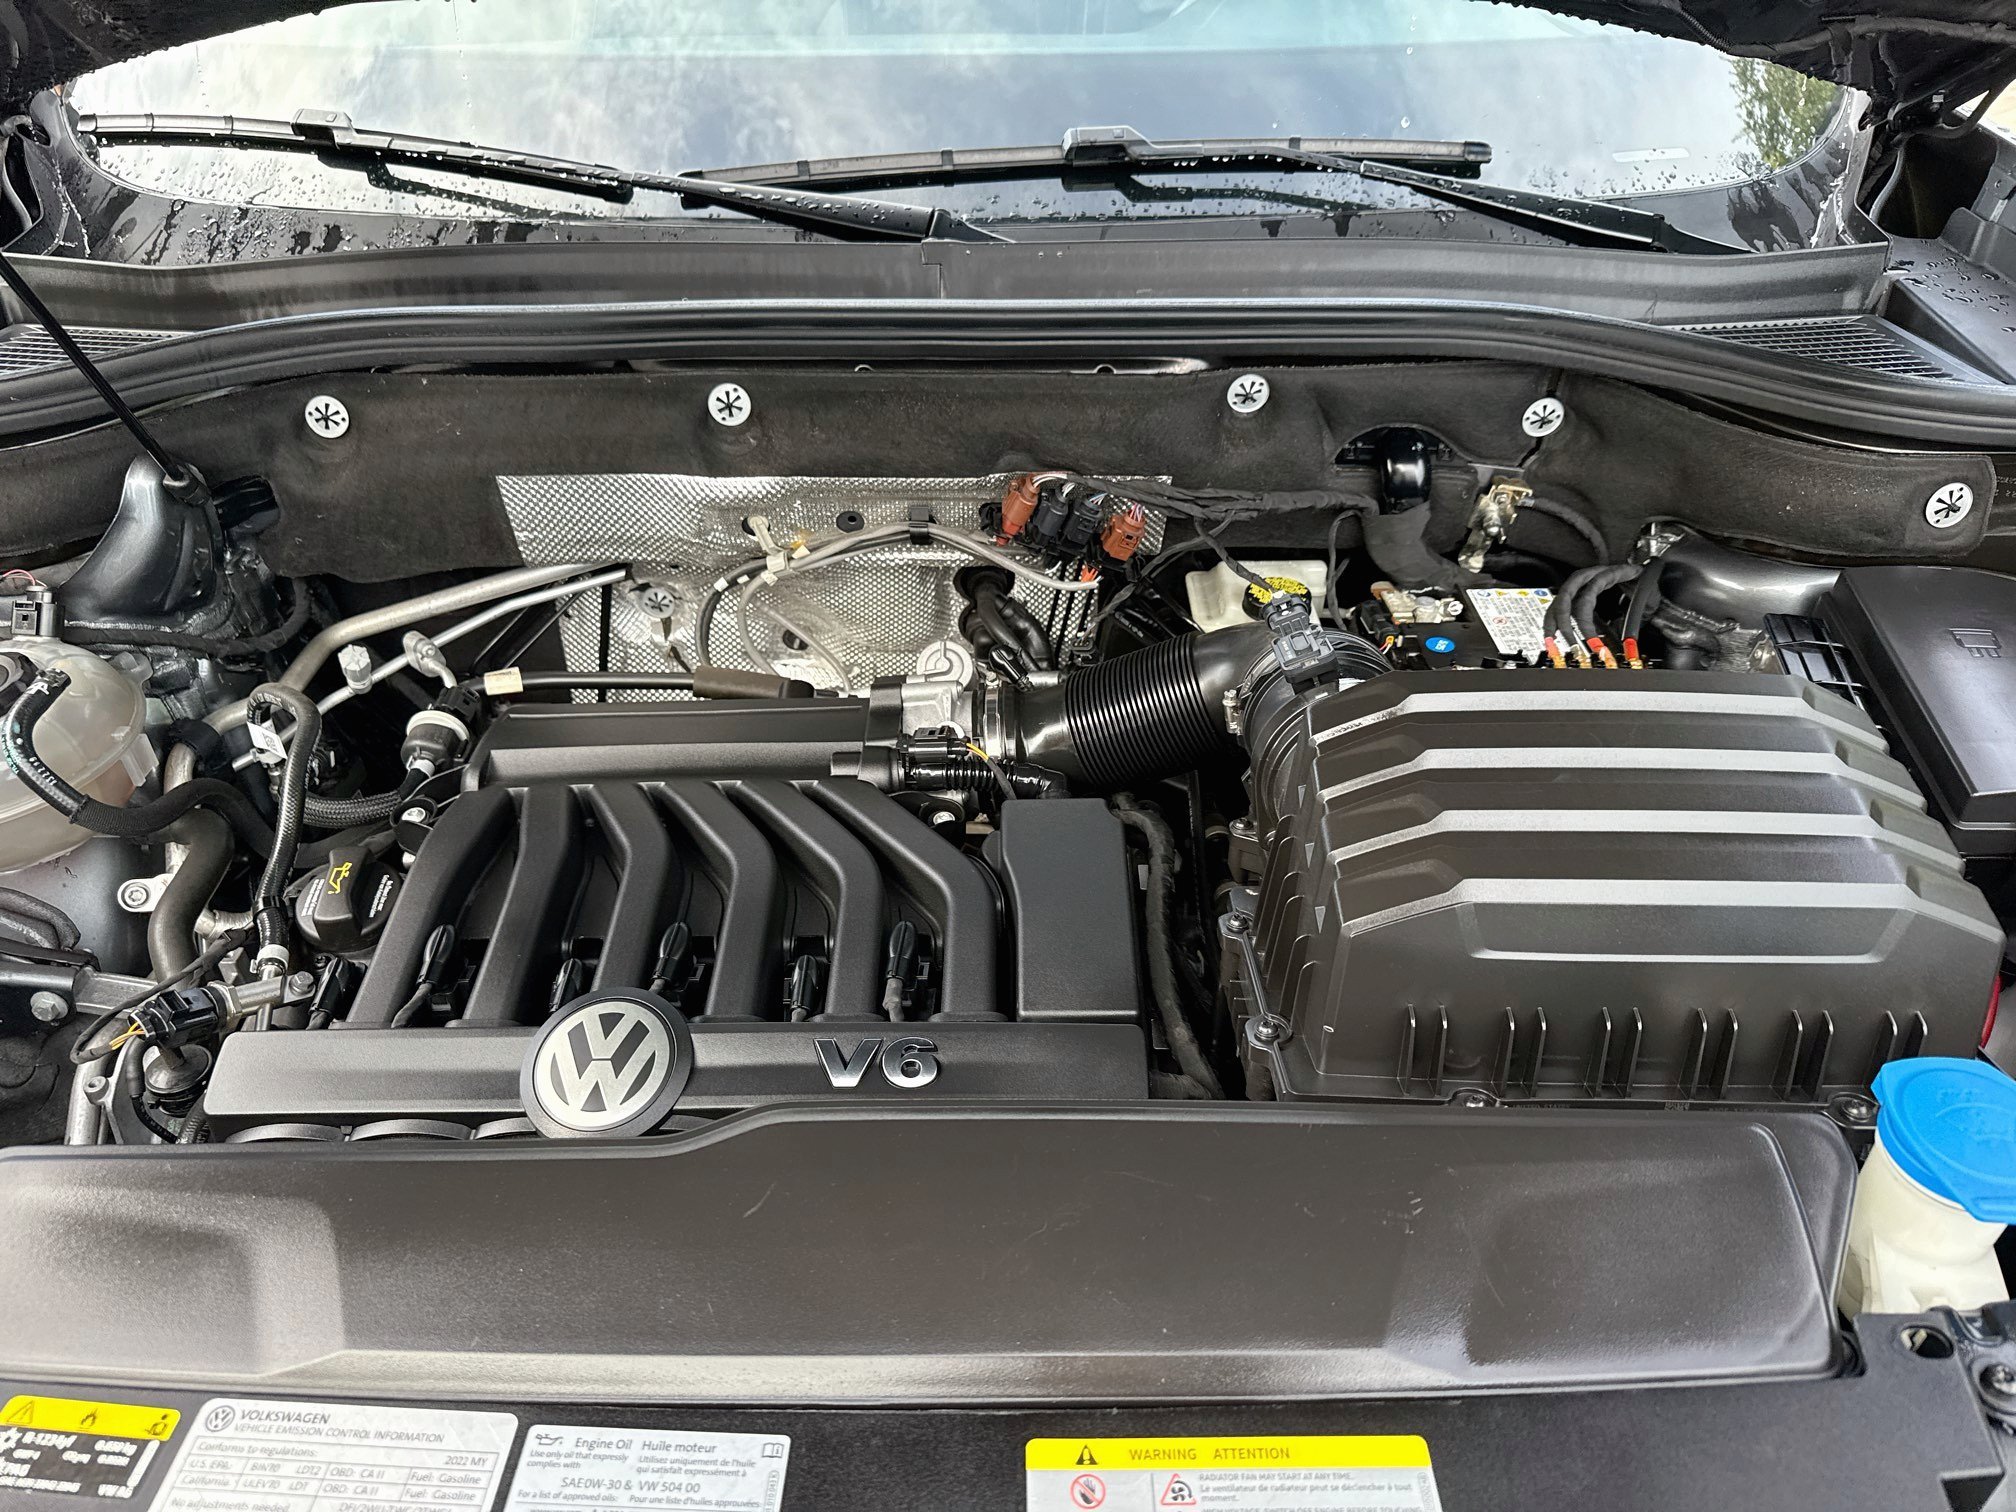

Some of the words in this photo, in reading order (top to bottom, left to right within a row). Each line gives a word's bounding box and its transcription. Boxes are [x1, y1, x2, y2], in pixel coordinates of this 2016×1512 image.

[813, 1036, 939, 1089] V6
[240, 1408, 332, 1425] VOLKSWAGEN
[234, 1422, 274, 1434] VEHICLE
[275, 1424, 324, 1437] EMISSION
[325, 1427, 371, 1440] CONTROL
[374, 1430, 445, 1443] INFORMATION
[198, 1440, 245, 1453] Conforms
[248, 1444, 258, 1454] to
[258, 1444, 318, 1457] regulations:
[575, 1437, 614, 1450] Engine
[616, 1439, 633, 1450] Oil
[642, 1440, 672, 1452] Huile
[674, 1442, 718, 1454] moteur
[546, 1450, 564, 1460] only
[564, 1451, 575, 1459] oil
[576, 1452, 592, 1460] that
[593, 1452, 629, 1462] expressly
[1128, 1448, 1197, 1460] WARNING
[1213, 1447, 1290, 1460] ATTENTION
[444, 1455, 468, 1466] 2022
[470, 1456, 489, 1466] MY
[526, 1460, 562, 1469] complies
[563, 1461, 582, 1469] with
[638, 1456, 670, 1464] Utilisez
[670, 1456, 719, 1467] uniquement
[720, 1458, 730, 1466] de
[330, 1467, 354, 1478] OBD:
[360, 1468, 374, 1478] CA
[636, 1466, 650, 1475] qui
[1199, 1472, 1240, 1481] RADIATOR
[1240, 1472, 1258, 1481] FAN
[1259, 1472, 1276, 1481] MAY
[1277, 1472, 1302, 1480] START
[1302, 1472, 1313, 1480] AT
[1314, 1472, 1331, 1480] ANY
[410, 1471, 434, 1483] Fuel:
[438, 1472, 482, 1485] Gasoline
[322, 1483, 349, 1494] OBD:
[353, 1484, 369, 1495] CA
[623, 1480, 633, 1490] &
[638, 1480, 659, 1492] VW
[660, 1482, 682, 1492] 504
[684, 1482, 701, 1493] 00
[1200, 1484, 1210, 1492] Le
[1212, 1484, 1257, 1492] ventilateur
[1258, 1484, 1269, 1492] de
[1270, 1484, 1307, 1492] radiateur
[404, 1488, 428, 1500] Fuel:
[432, 1490, 477, 1501] Gasoline
[518, 1490, 531, 1498] For
[538, 1490, 551, 1499] list
[552, 1491, 562, 1499] of
[562, 1492, 600, 1502] approved
[629, 1494, 650, 1504] Pour
[650, 1497, 666, 1505] une
[666, 1496, 682, 1505] liste
